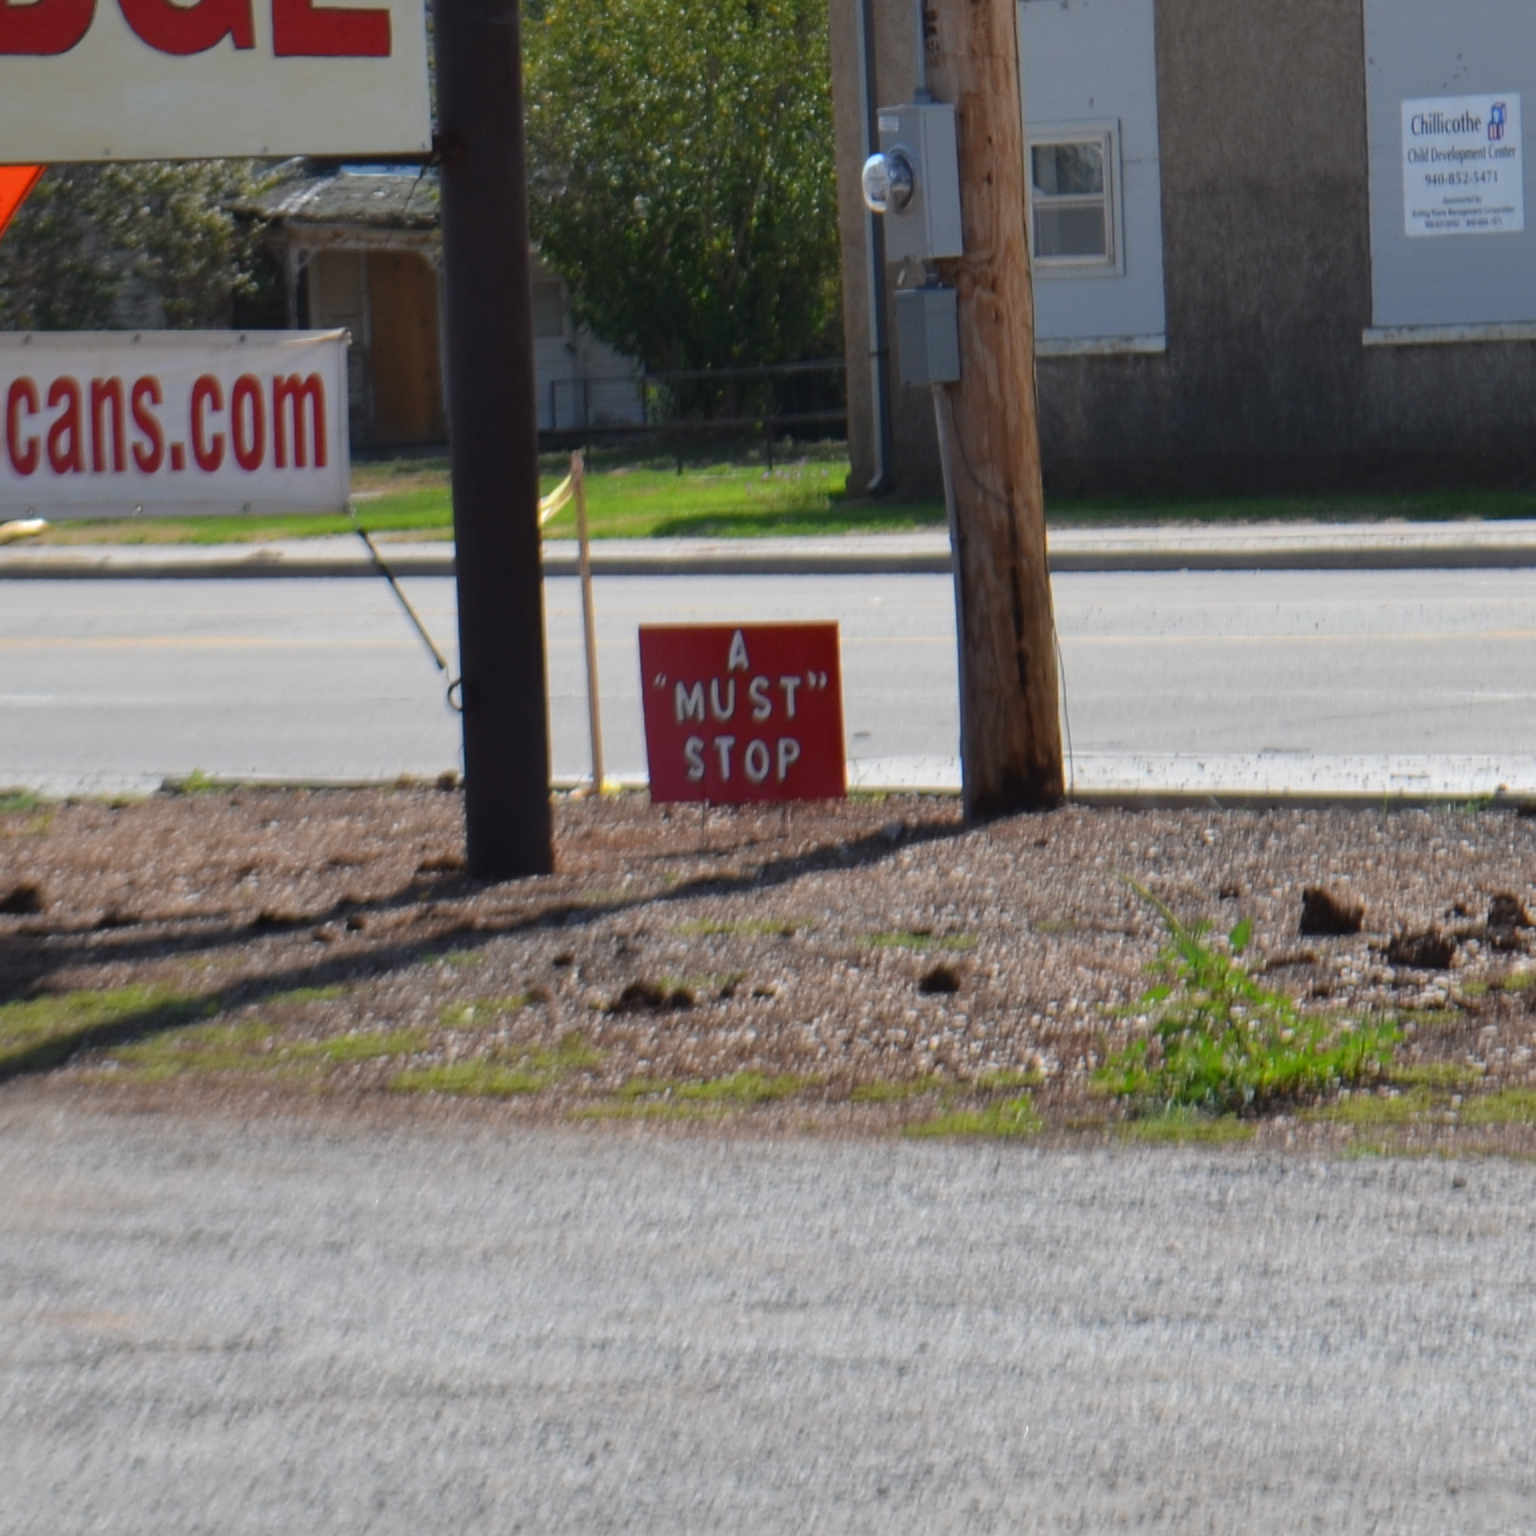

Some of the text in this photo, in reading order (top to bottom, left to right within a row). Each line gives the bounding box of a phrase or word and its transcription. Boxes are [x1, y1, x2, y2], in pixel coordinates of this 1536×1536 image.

[1411, 111, 1481, 136] Chillicothe
[1408, 144, 1516, 166] Child Development Center
[728, 629, 749, 670] A
[684, 735, 801, 783] STOP
